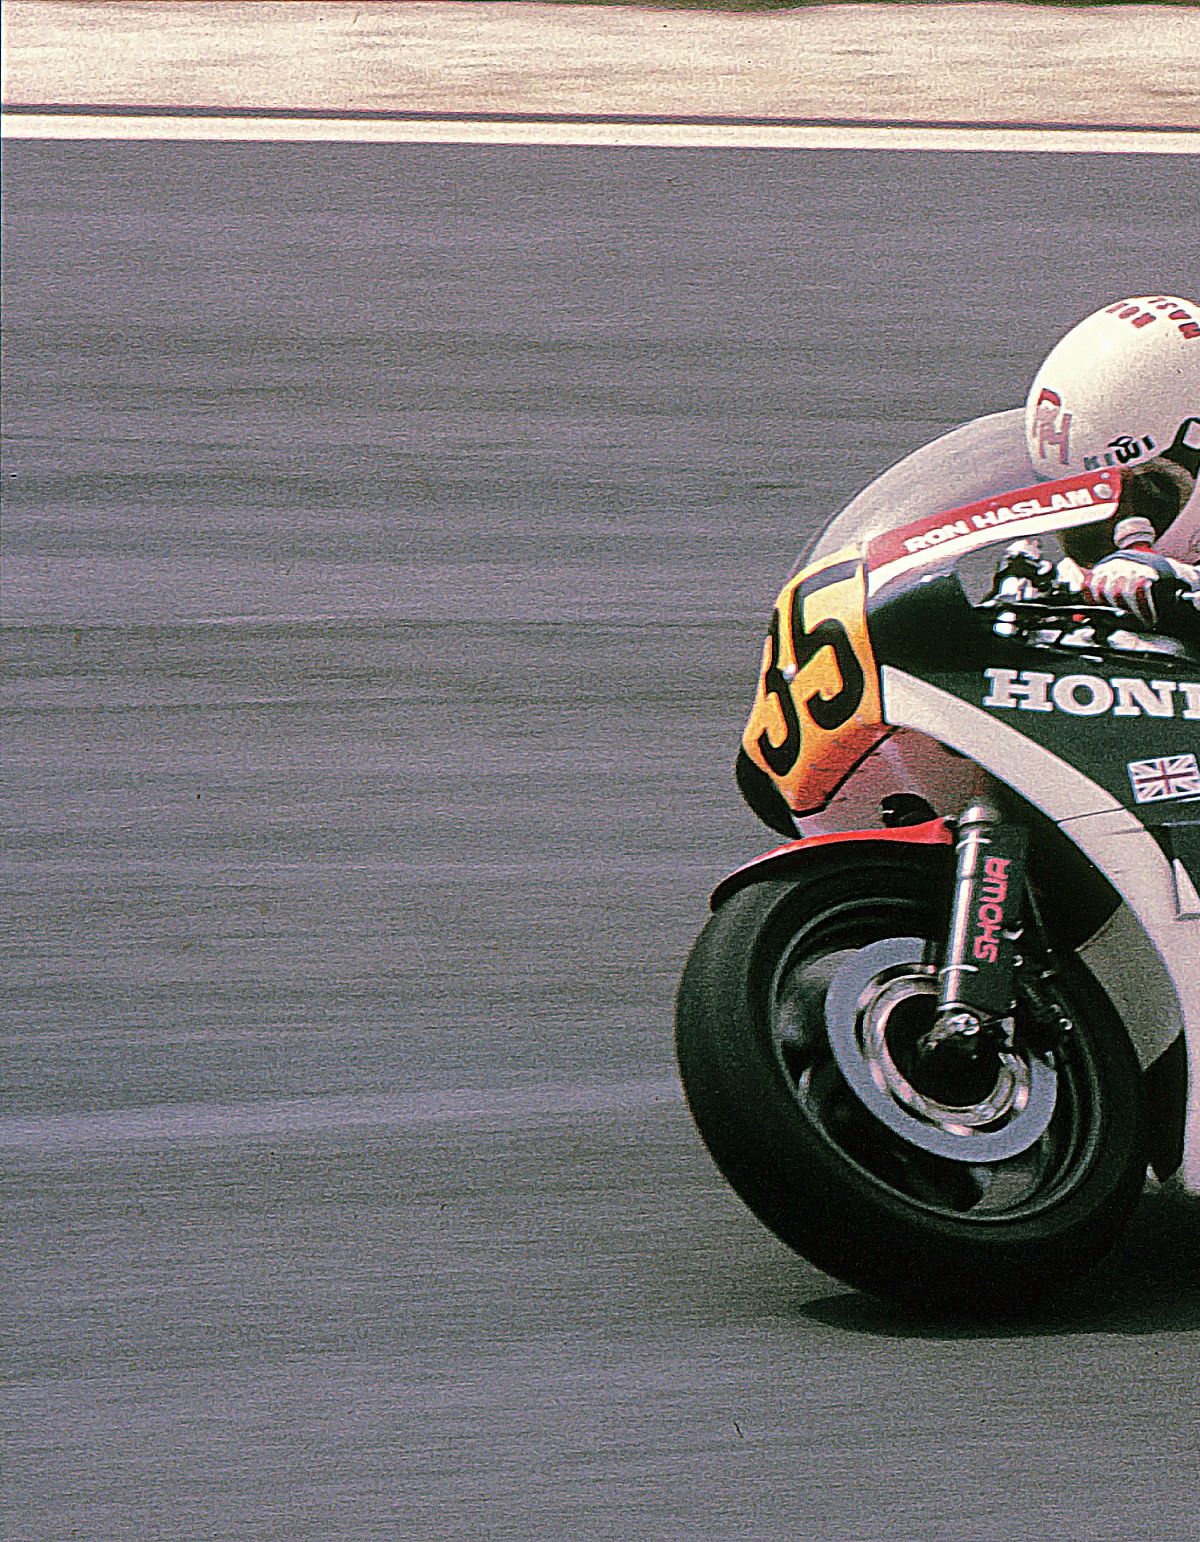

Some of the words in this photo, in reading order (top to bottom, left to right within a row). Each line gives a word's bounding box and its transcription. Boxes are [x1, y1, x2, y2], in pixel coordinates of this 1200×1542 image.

[903, 520, 971, 553] RON
[971, 488, 1095, 529] HASLAM
[758, 558, 866, 777] 35
[974, 856, 1012, 963] SHOWA
